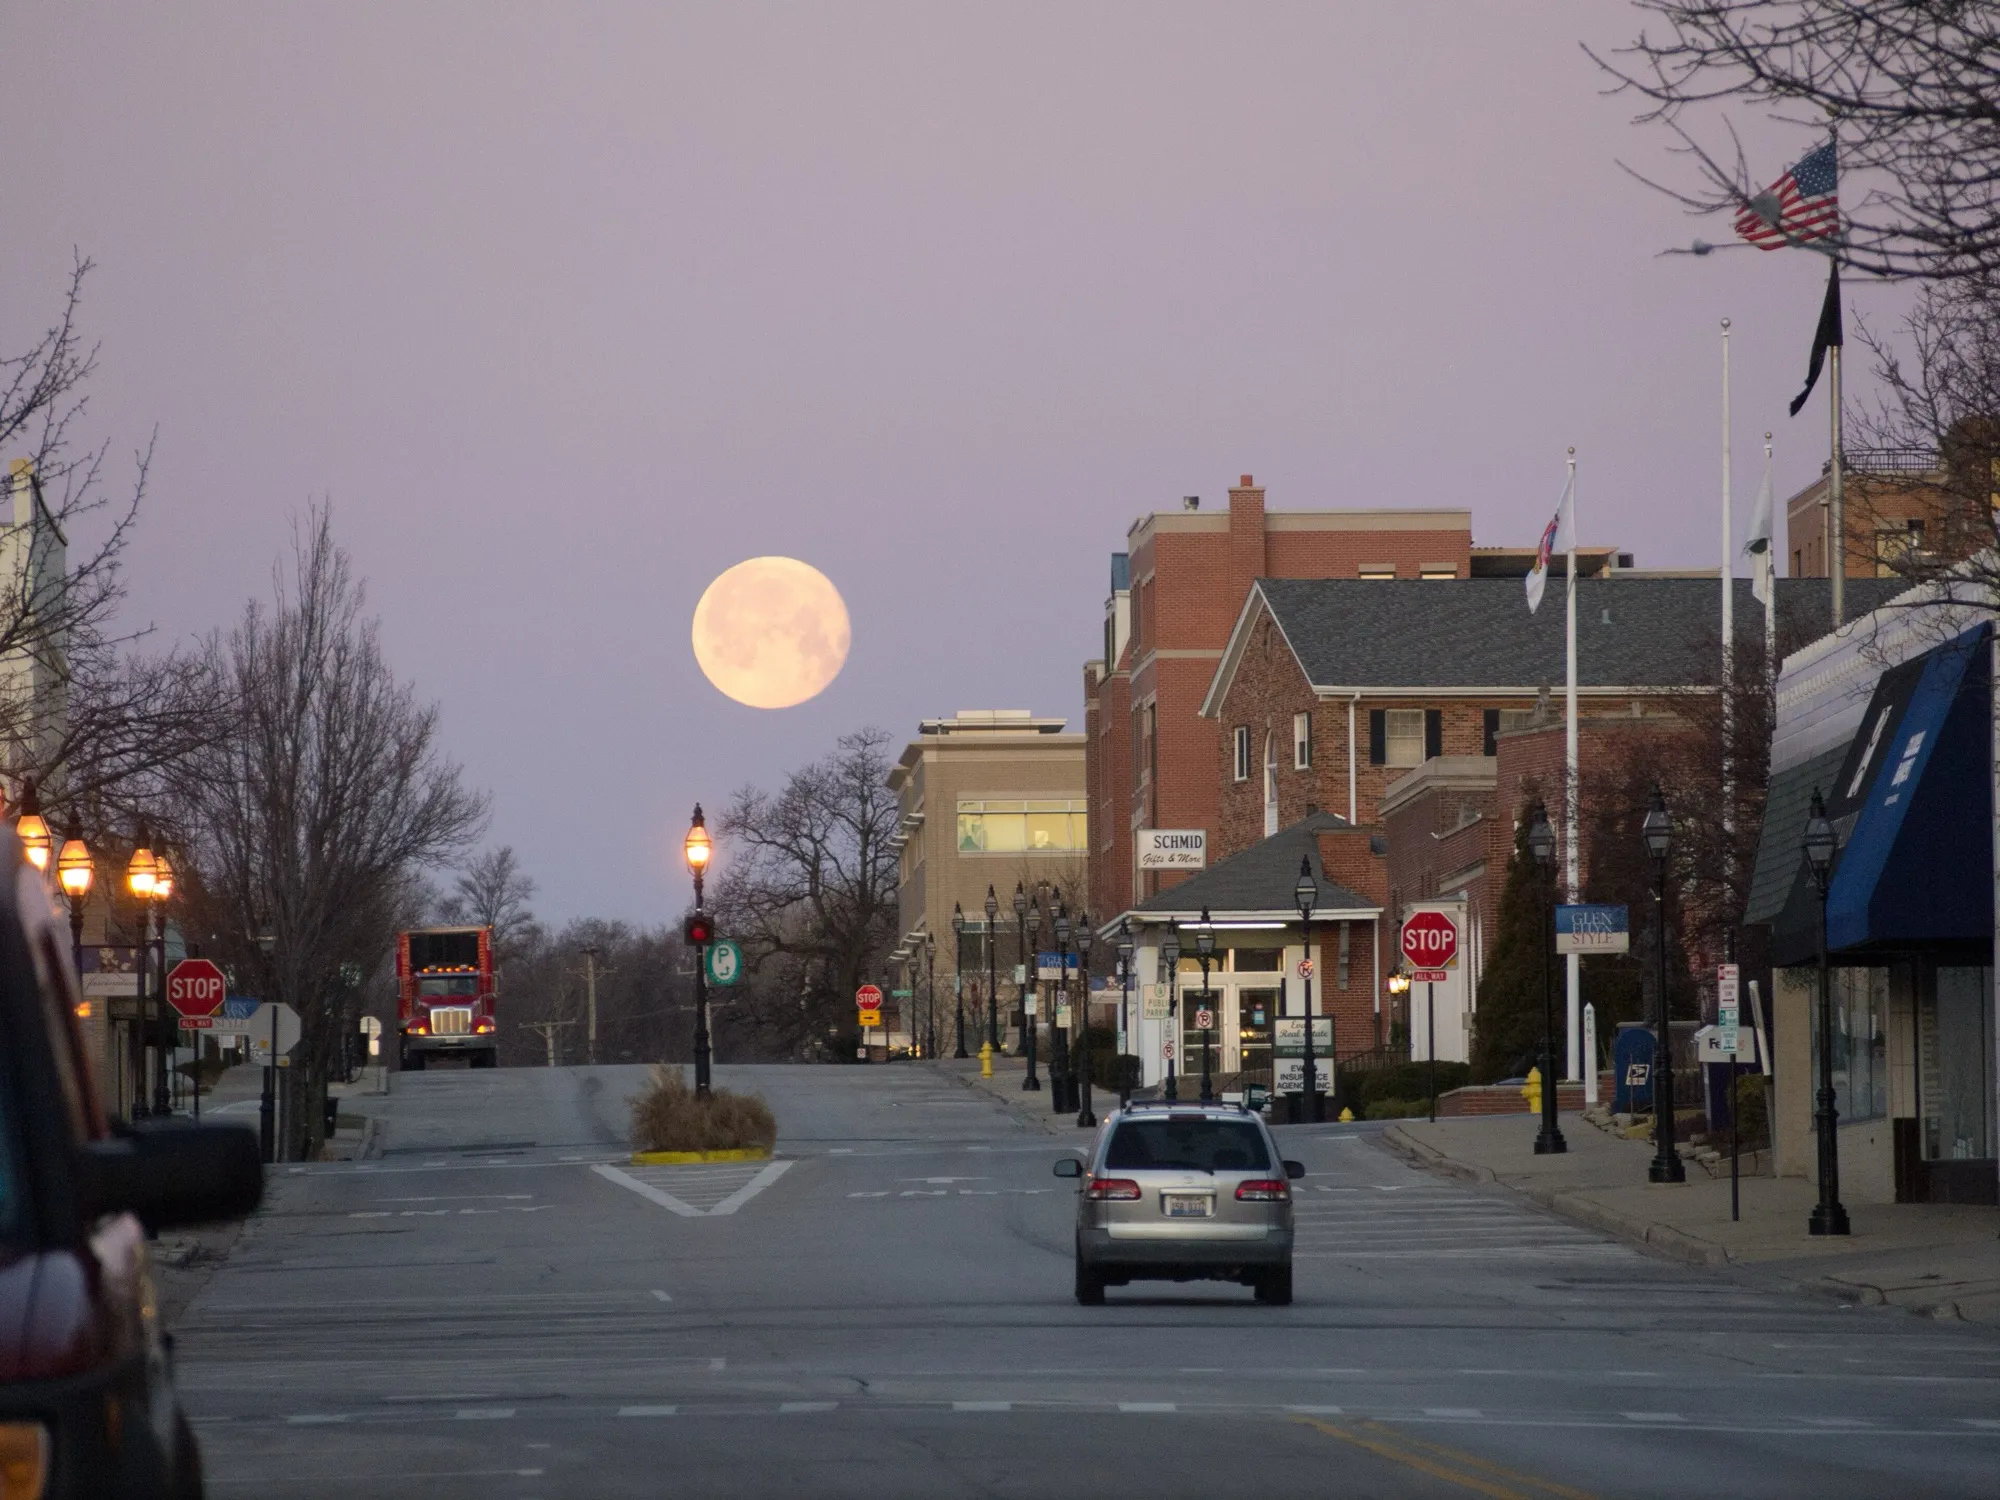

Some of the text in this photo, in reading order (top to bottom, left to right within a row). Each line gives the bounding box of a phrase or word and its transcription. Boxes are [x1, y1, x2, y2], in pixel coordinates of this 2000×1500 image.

[1154, 835, 1202, 849] SCHMID
[1142, 853, 1201, 865] Gifts & More
[1572, 912, 1612, 924] GLEN
[1405, 929, 1454, 951] STOP
[1572, 933, 1613, 945] STYLE
[171, 978, 222, 999] STOP
[858, 993, 880, 1003] STOP
[1148, 1000, 1169, 1008] PUBLI
[1146, 1009, 1170, 1017] PARKIN
[181, 1019, 211, 1027] ALL WAY
[1279, 1030, 1300, 1038] Real
[1317, 1082, 1332, 1090] INC.
